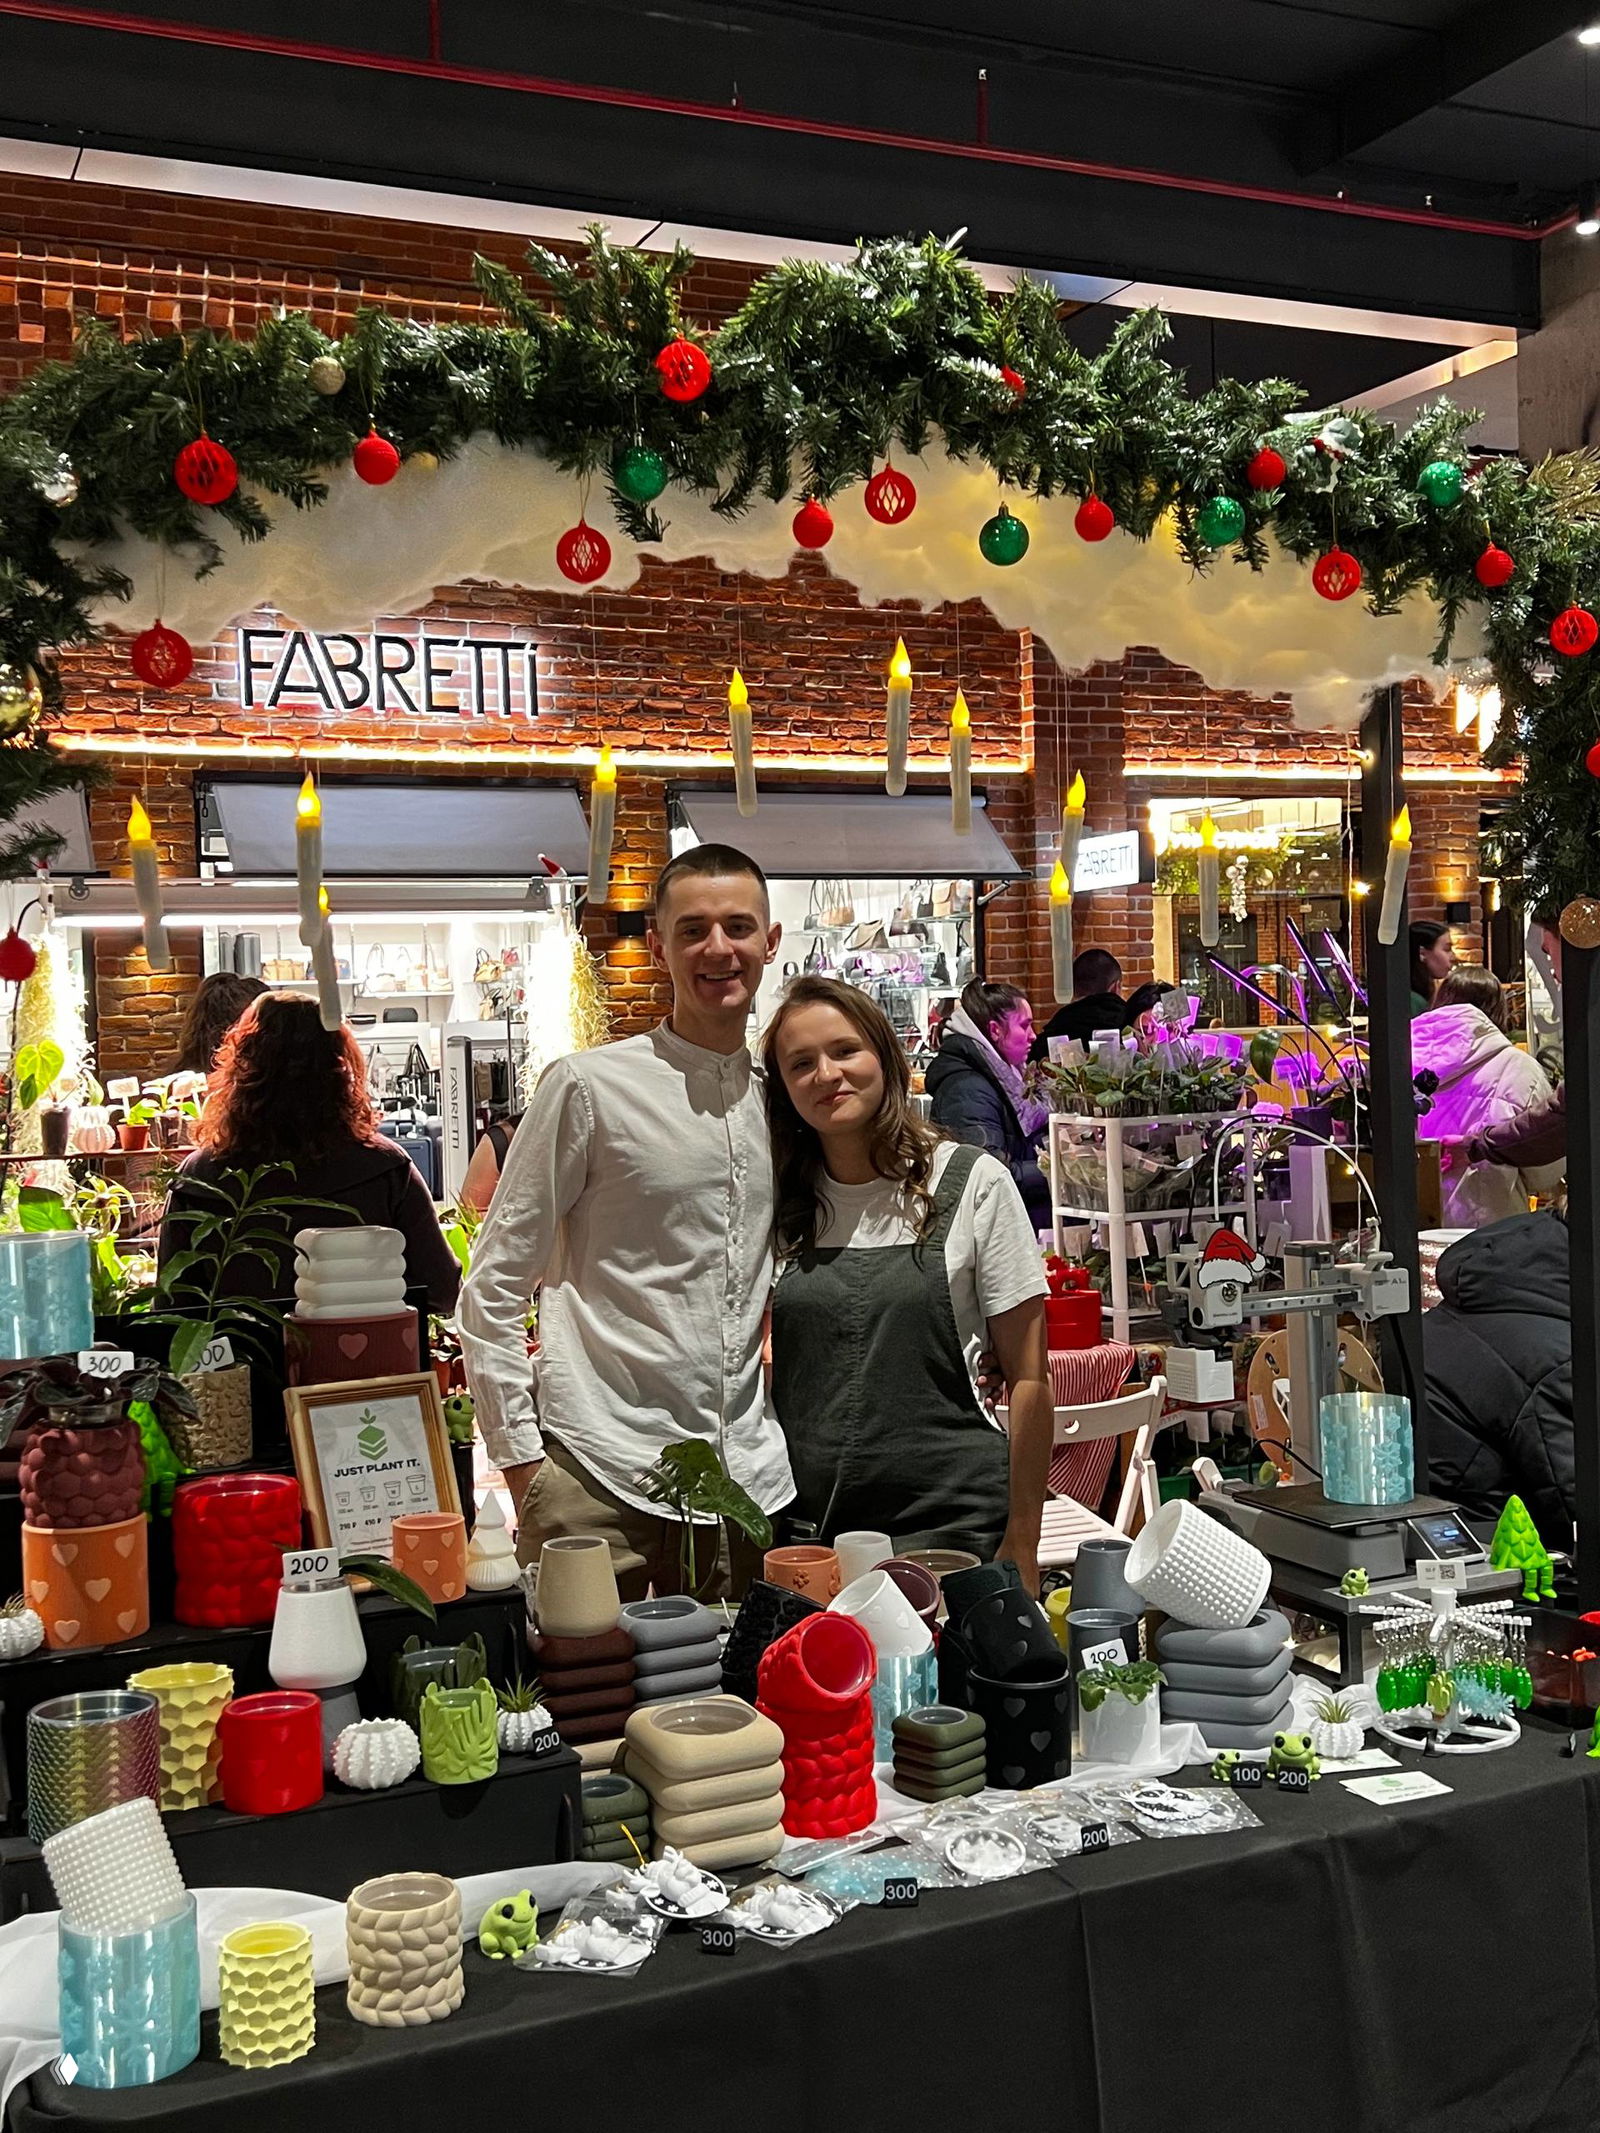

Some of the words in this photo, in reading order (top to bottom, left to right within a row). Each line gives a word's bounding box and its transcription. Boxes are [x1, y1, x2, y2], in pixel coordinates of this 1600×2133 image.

[238, 628, 539, 719] FABRETTI
[450, 1067, 460, 1149] FABRETTI
[88, 1356, 121, 1373] 300
[334, 1466, 364, 1478] JUST
[366, 1460, 404, 1473] PLANT
[407, 1458, 421, 1467] IT.
[291, 1556, 329, 1575] 200
[1090, 1648, 1118, 1664] 200
[535, 1731, 560, 1752] 200
[1233, 1768, 1261, 1781] 100
[1279, 1771, 1307, 1786] 200
[1083, 1829, 1107, 1847] 200
[885, 1884, 917, 1899] 300
[702, 1930, 733, 1947] 300
